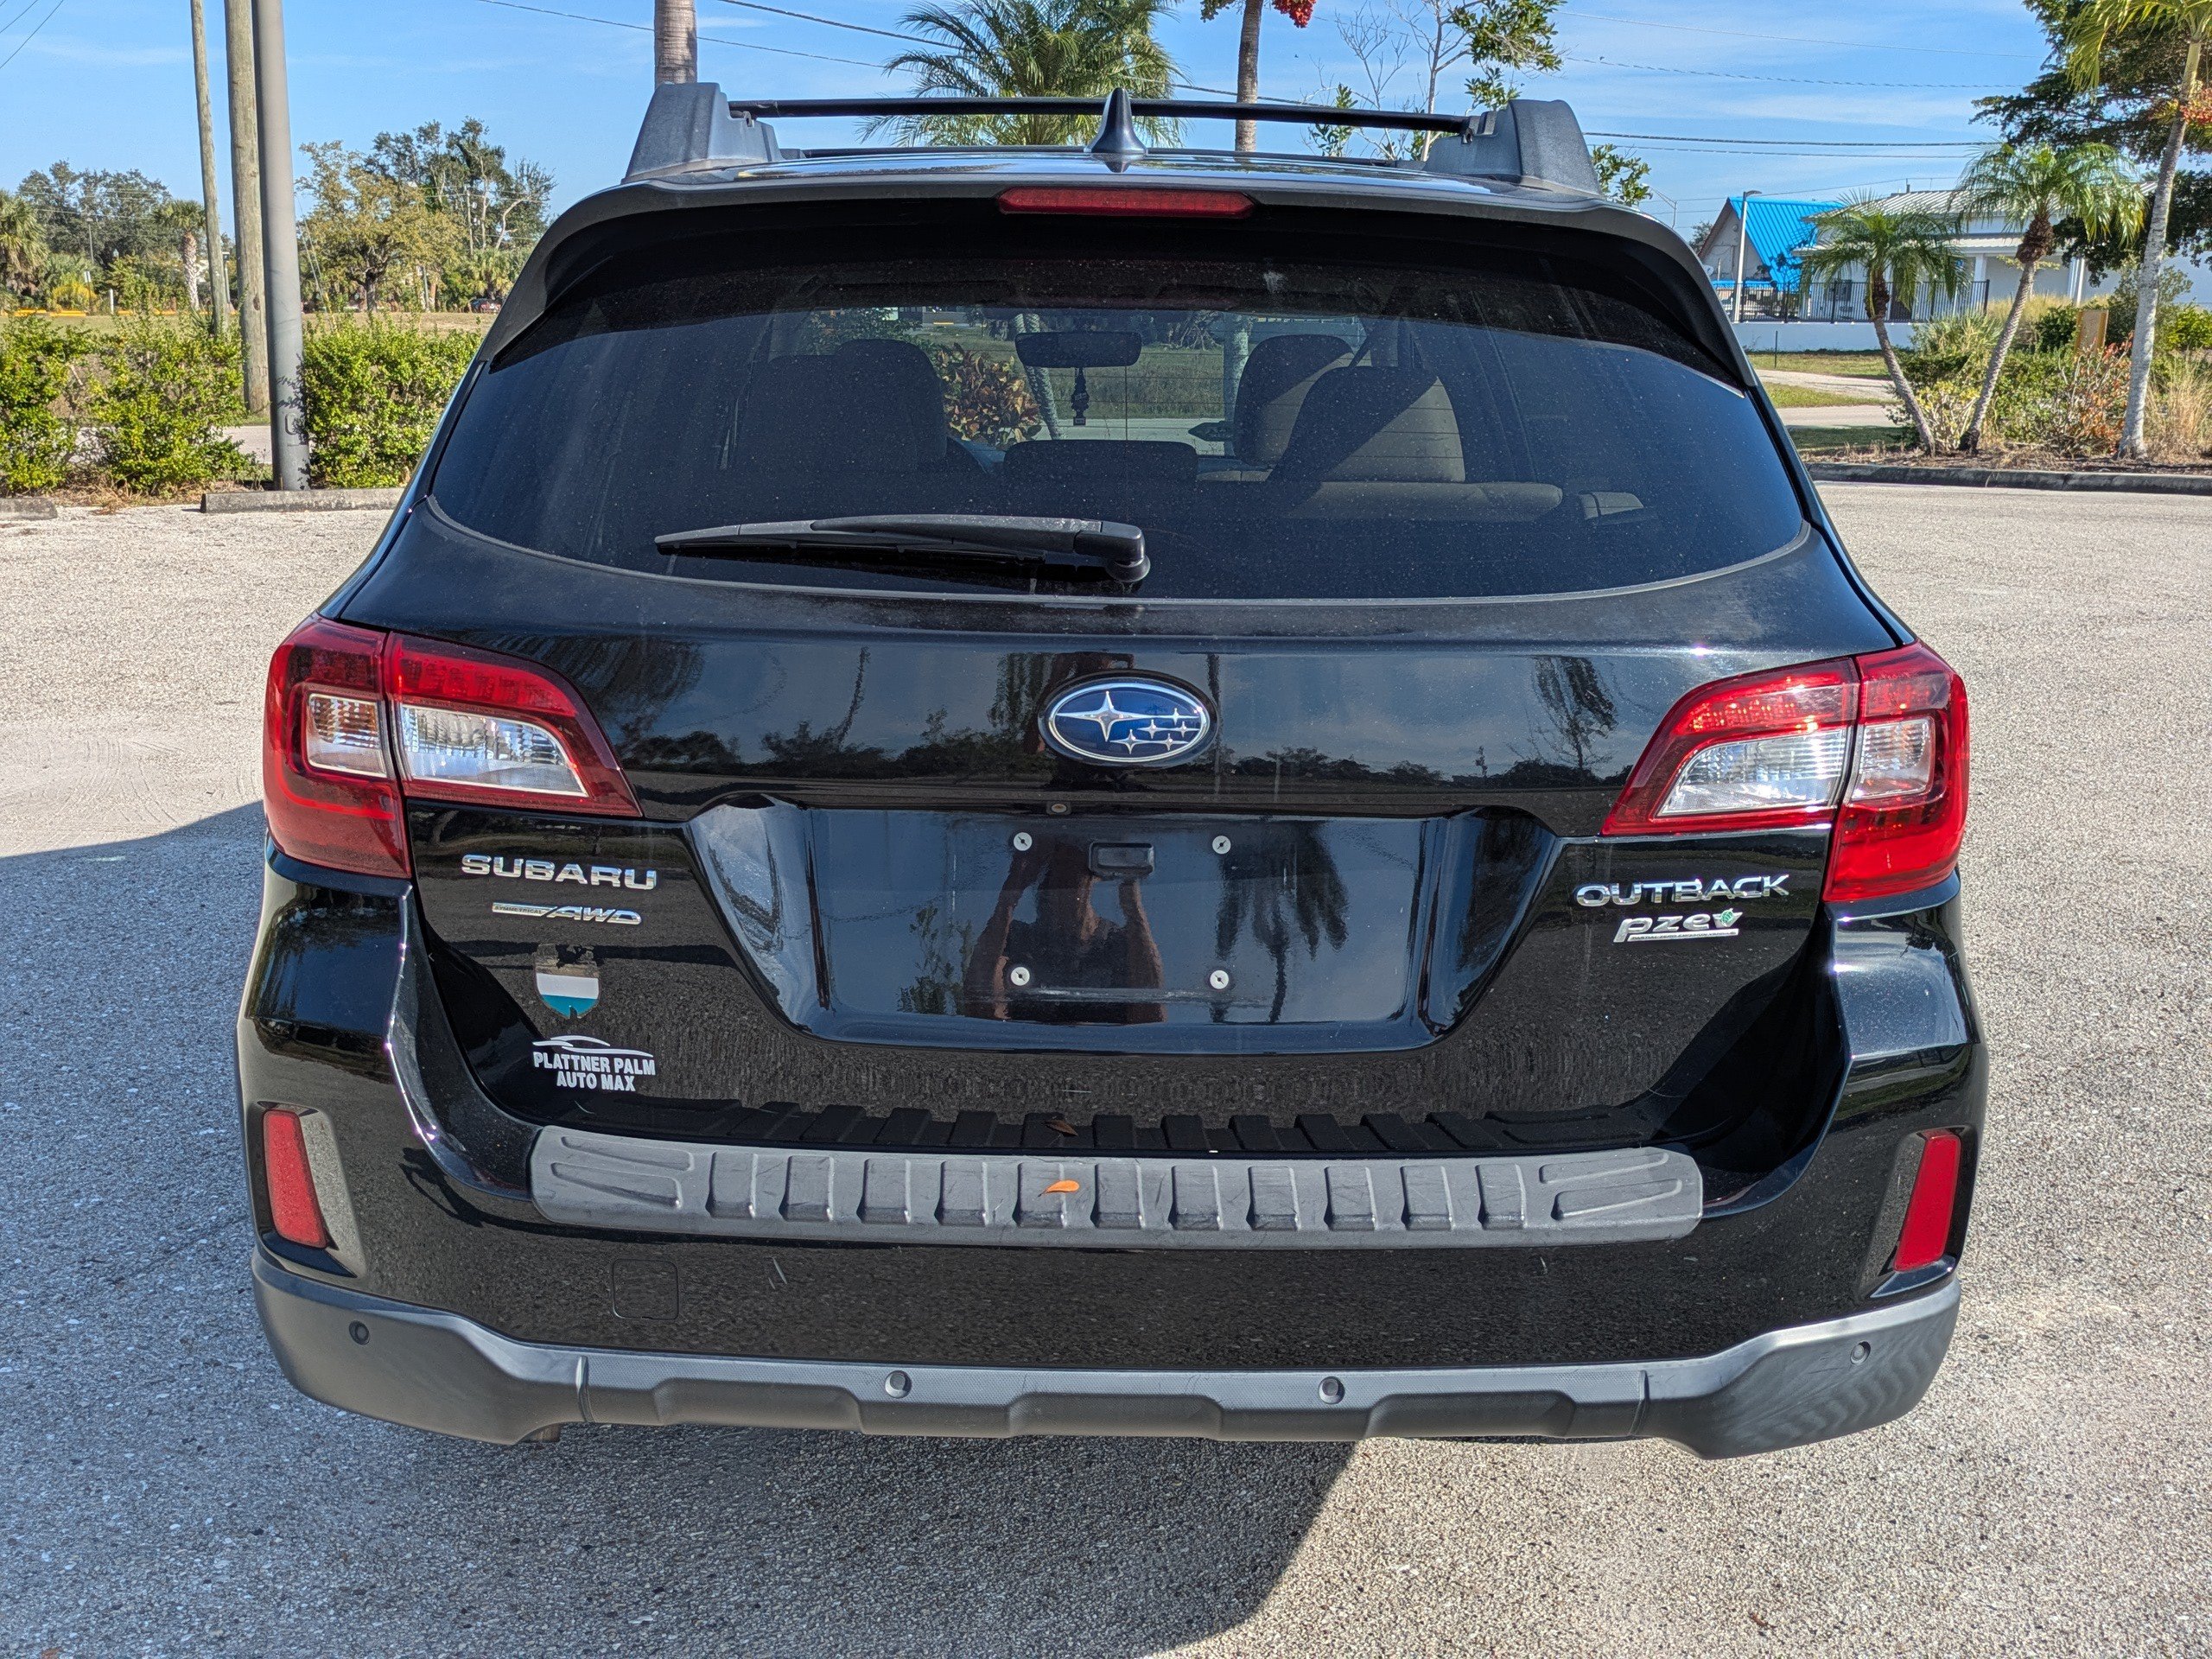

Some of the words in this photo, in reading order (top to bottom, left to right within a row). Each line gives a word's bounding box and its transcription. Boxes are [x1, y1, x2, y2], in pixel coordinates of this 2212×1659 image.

[461, 854, 657, 890] SUBARU
[1575, 874, 1789, 907] OUTBACK
[546, 906, 642, 925] AWD
[533, 1052, 610, 1073] PLATTNER
[613, 1058, 656, 1076] PALM
[556, 1071, 597, 1090] AUTO
[601, 1074, 636, 1092] MAX
